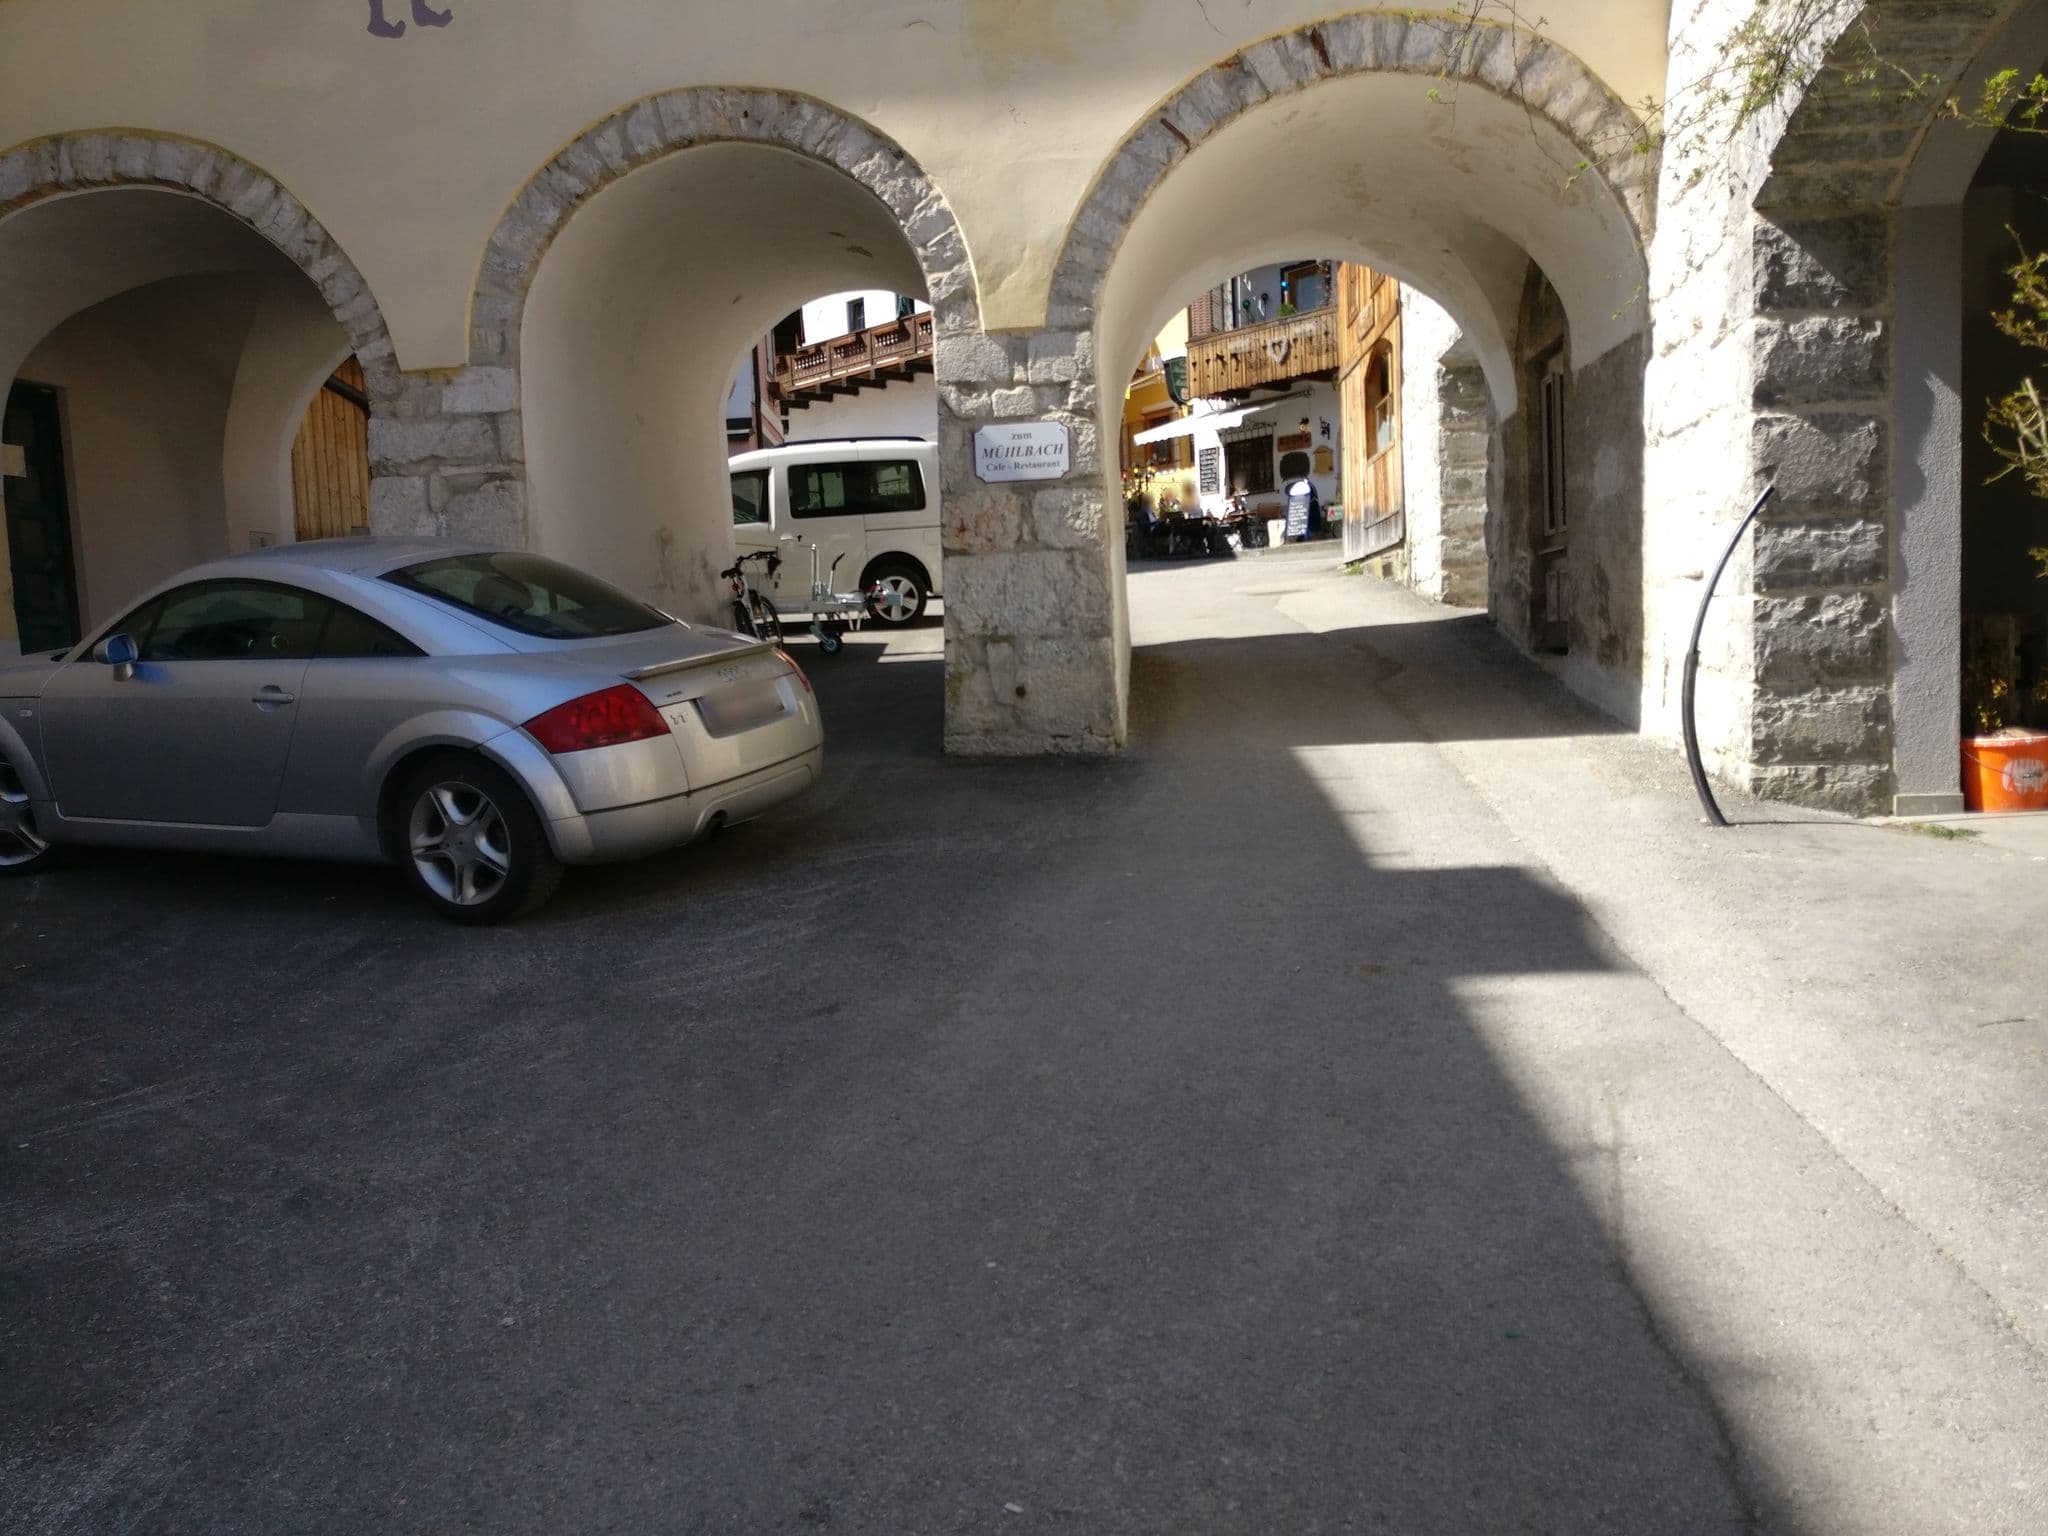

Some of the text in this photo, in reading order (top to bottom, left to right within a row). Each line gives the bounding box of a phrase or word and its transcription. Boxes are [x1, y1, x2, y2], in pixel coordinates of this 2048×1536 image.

[1011, 432, 1032, 440] zum
[982, 443, 1064, 459] MÜHLBACH
[1014, 460, 1060, 470] Restaurant
